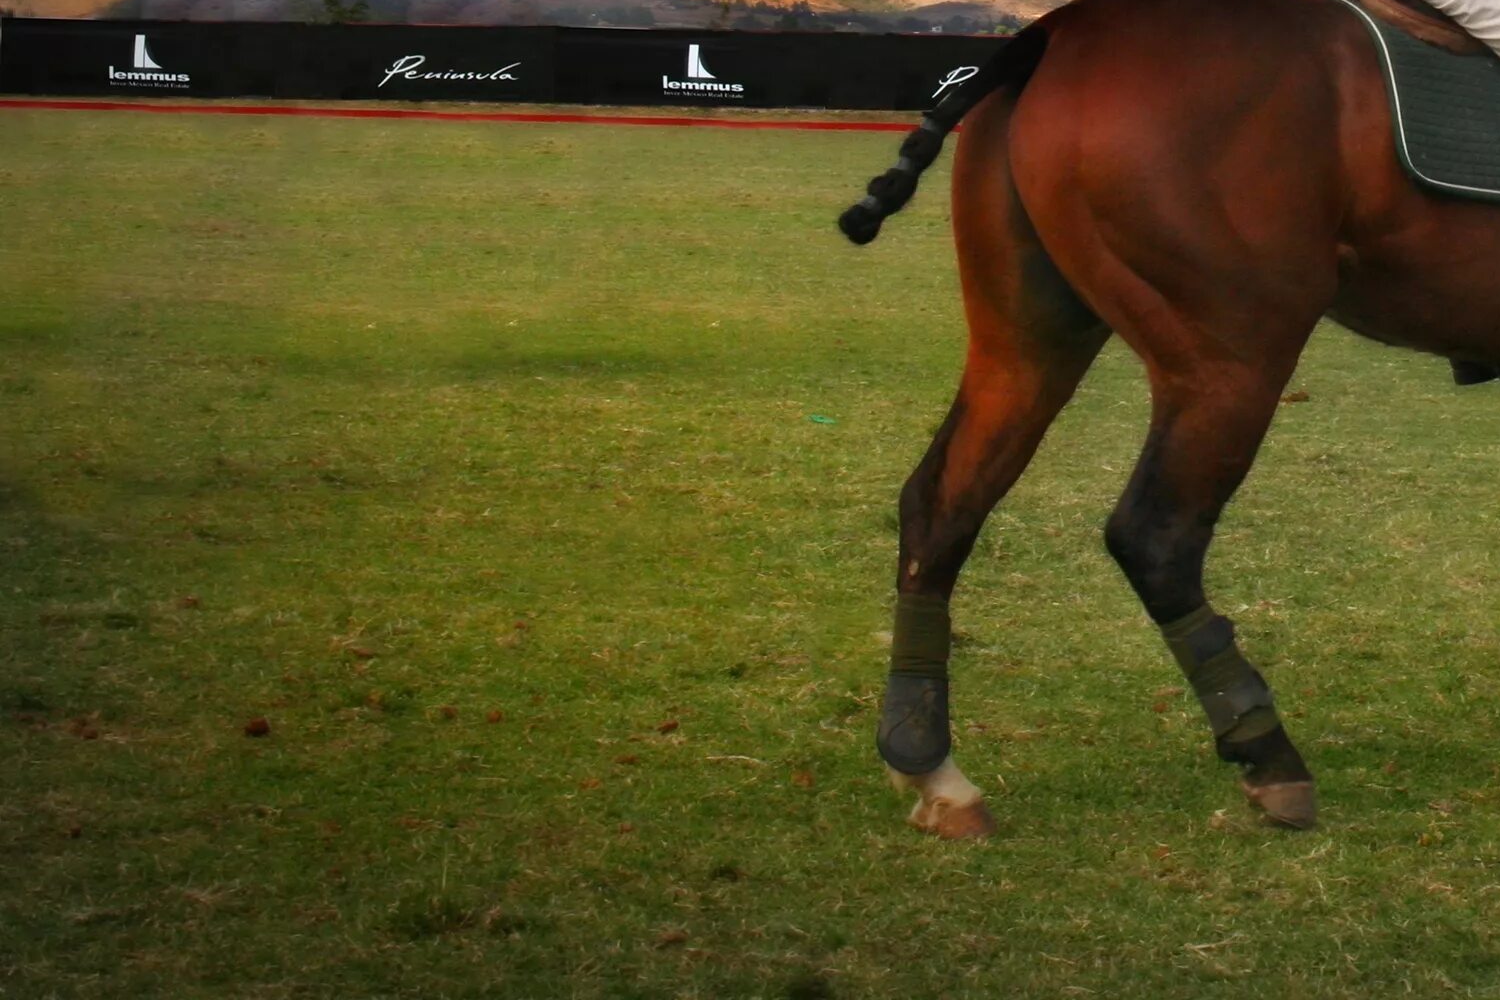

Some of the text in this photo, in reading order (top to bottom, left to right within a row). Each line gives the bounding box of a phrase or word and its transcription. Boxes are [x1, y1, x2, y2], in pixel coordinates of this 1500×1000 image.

[108, 65, 190, 82] lemmus
[378, 54, 521, 88] Peninsula
[662, 75, 744, 92] lemmus
